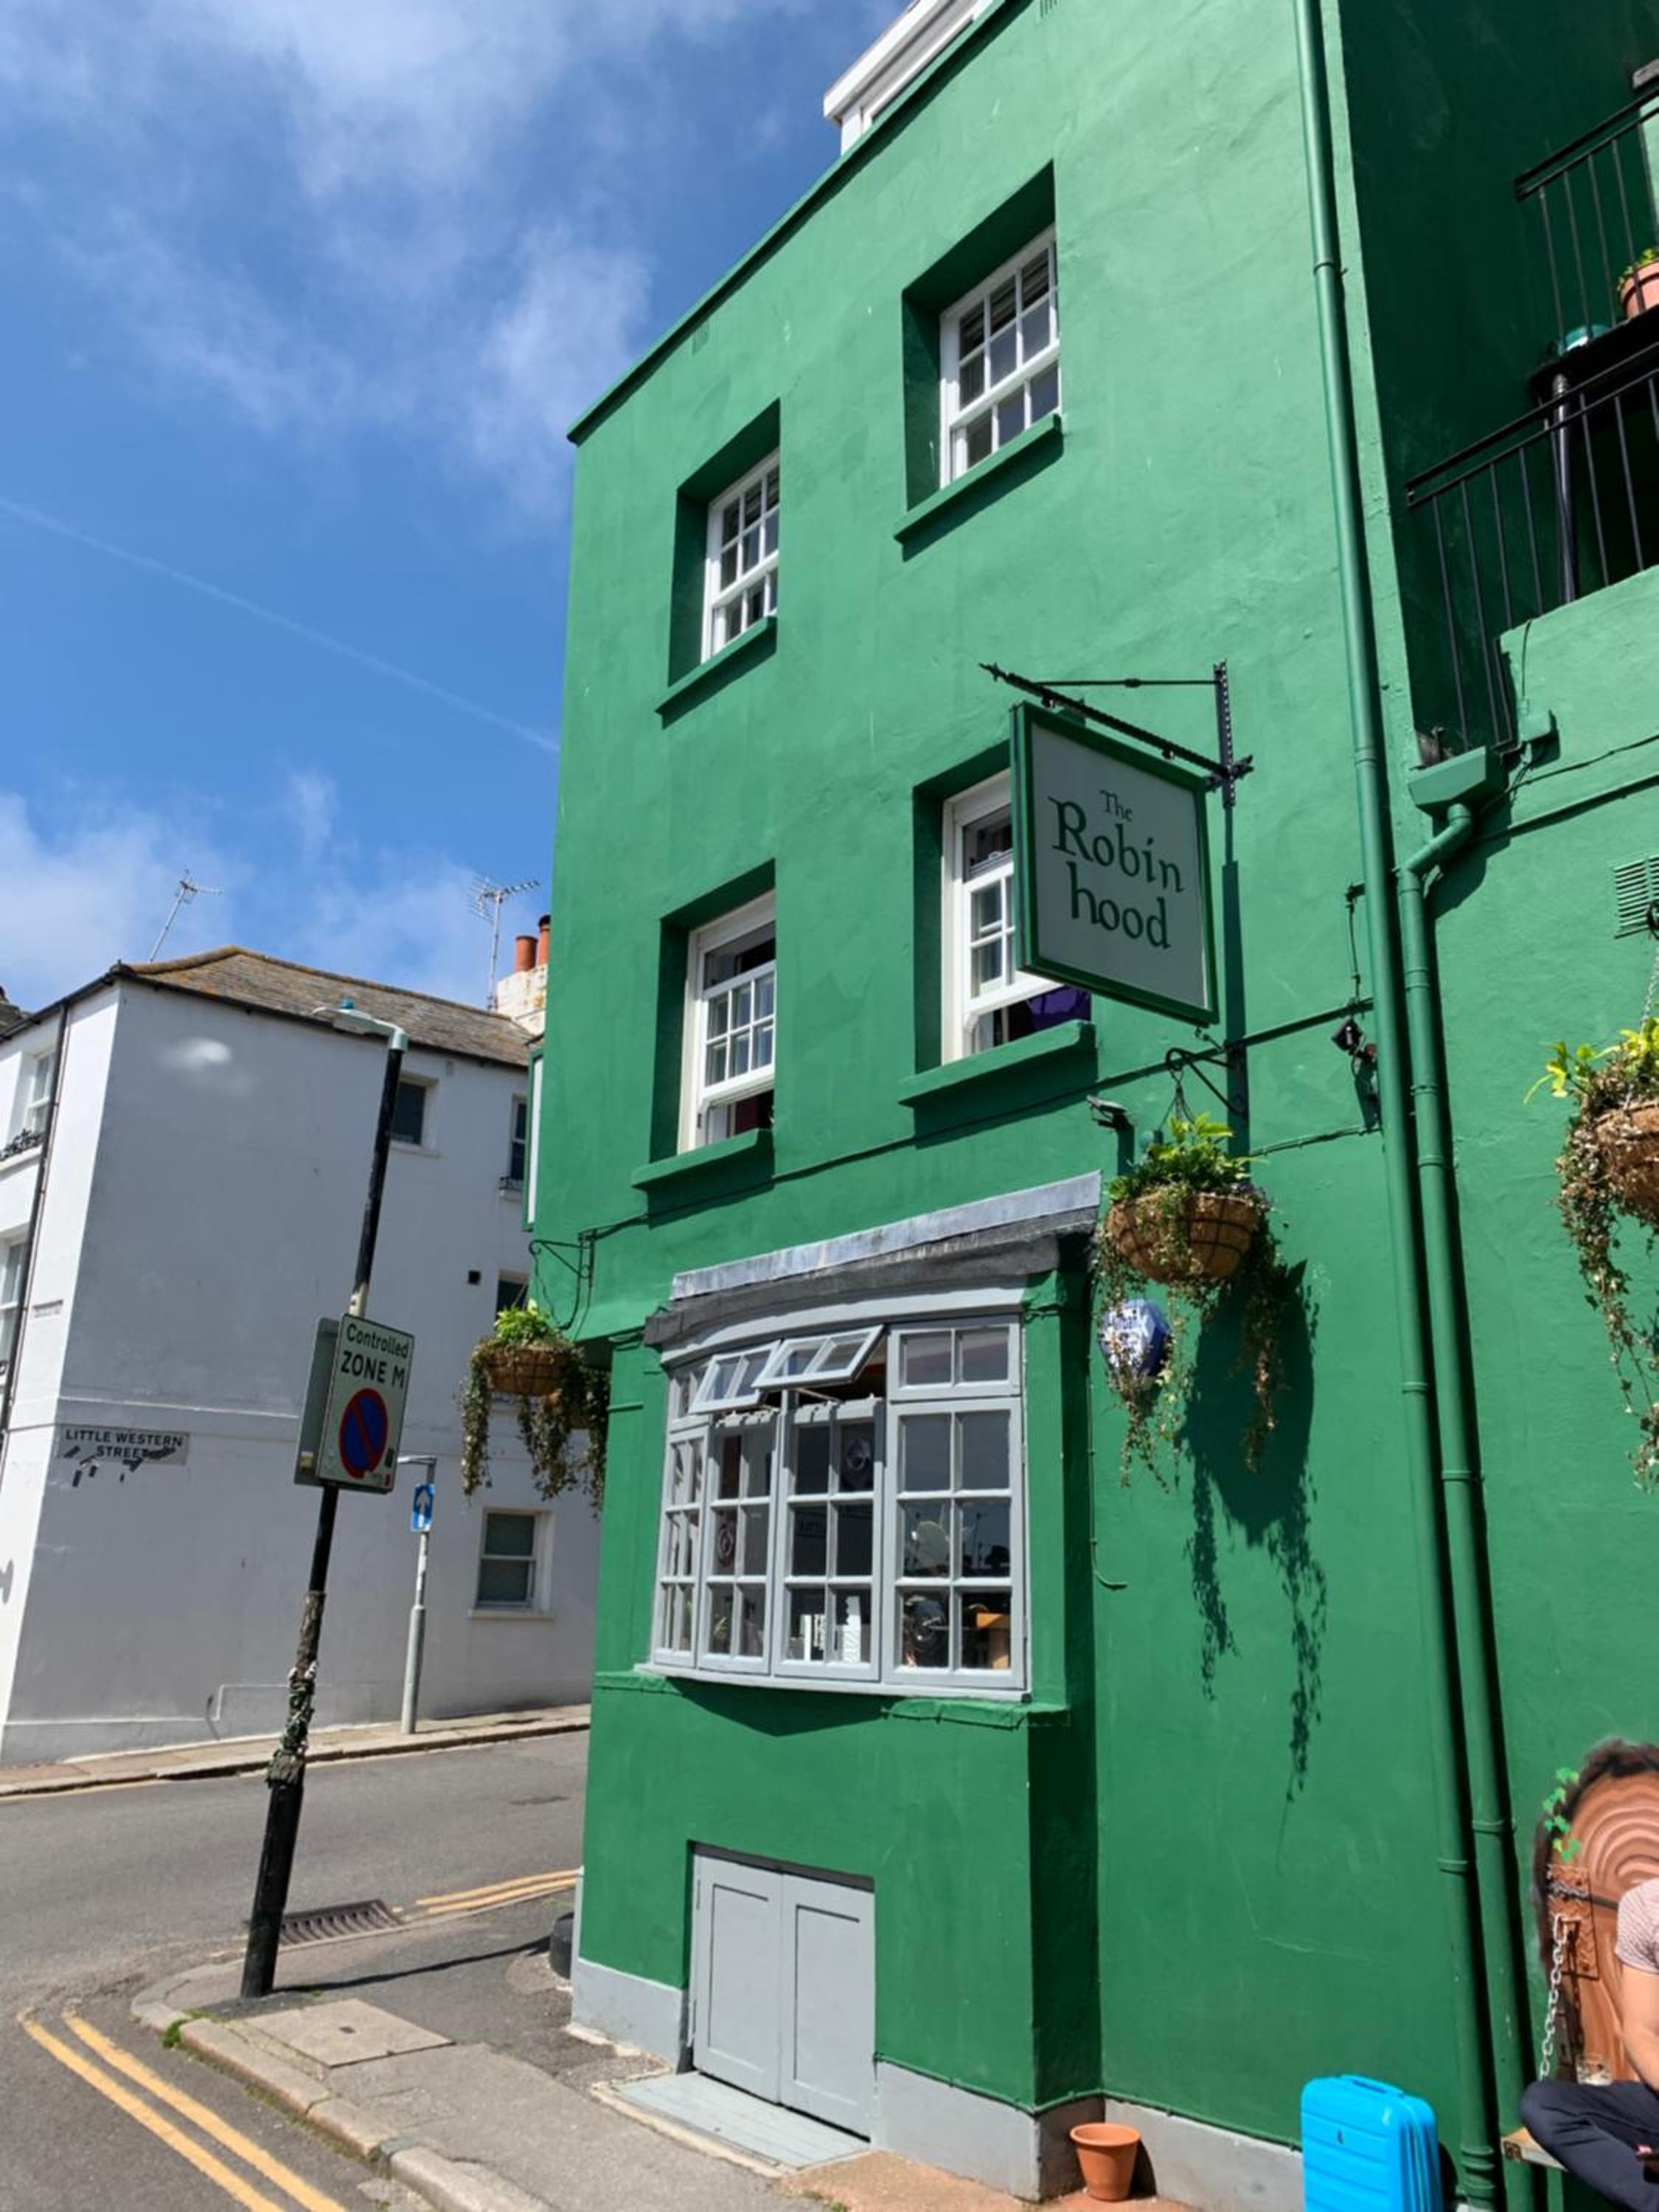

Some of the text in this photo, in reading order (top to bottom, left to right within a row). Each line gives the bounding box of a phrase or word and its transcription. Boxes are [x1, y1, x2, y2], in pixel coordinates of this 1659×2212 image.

[1099, 790, 1133, 822] The
[1047, 796, 1184, 893] Robin
[1066, 861, 1171, 950] hood
[346, 1324, 409, 1358] Controlled
[341, 1350, 406, 1389] ZONE M
[66, 1429, 183, 1447] LITTLE WESTERN
